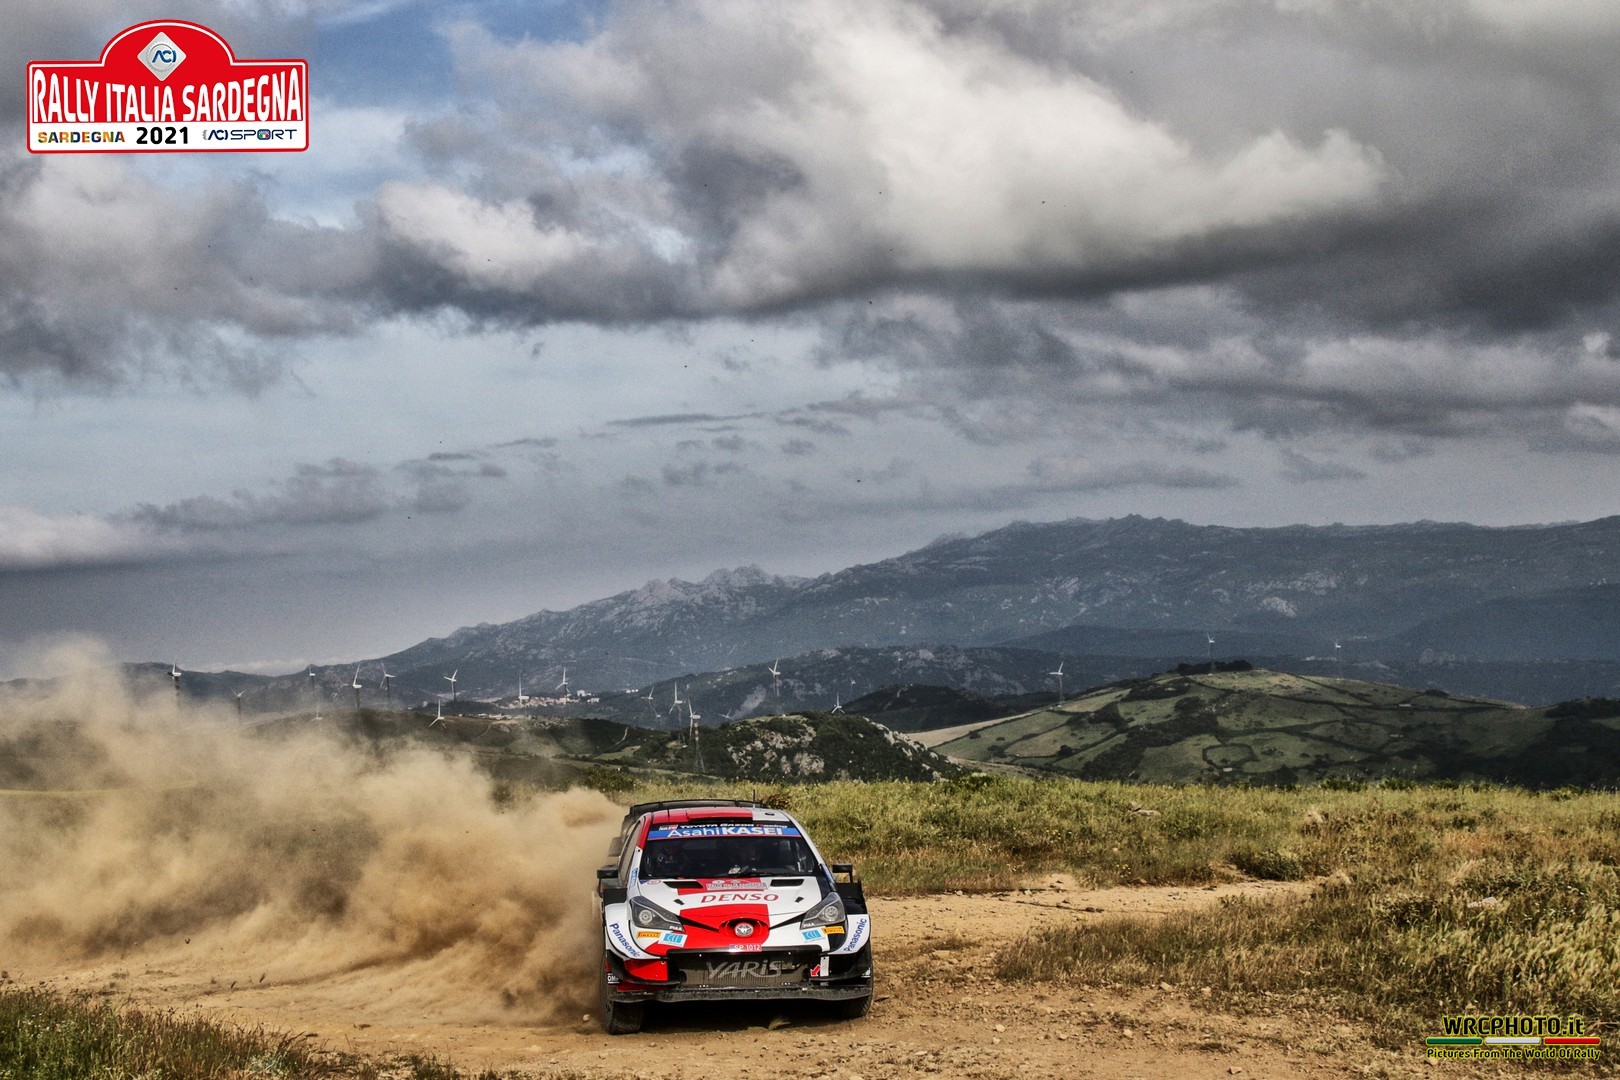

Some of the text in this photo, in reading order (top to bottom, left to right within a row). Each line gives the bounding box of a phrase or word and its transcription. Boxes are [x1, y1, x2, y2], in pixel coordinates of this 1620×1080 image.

[701, 893, 779, 903] DENSO
[609, 922, 641, 958] Panasonic
[843, 918, 868, 952] Panasonic
